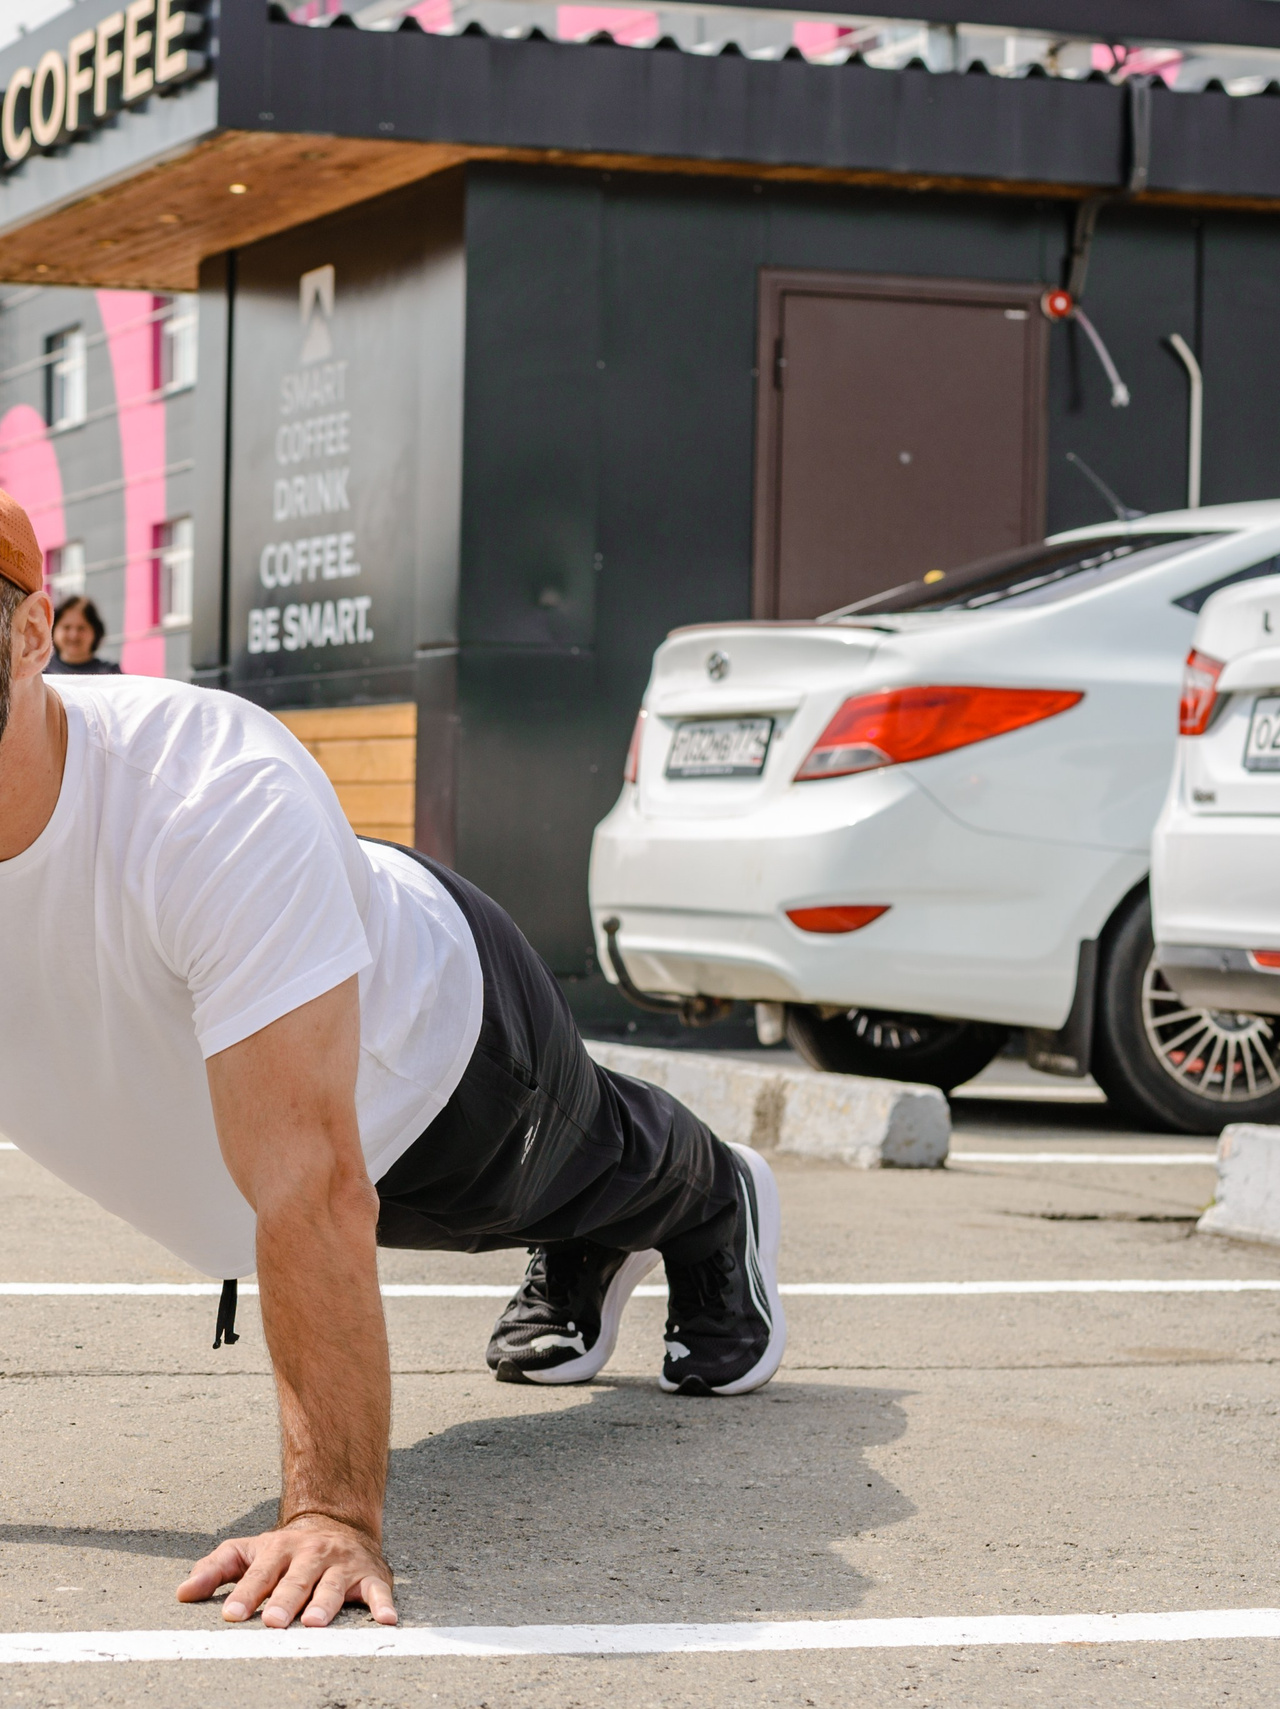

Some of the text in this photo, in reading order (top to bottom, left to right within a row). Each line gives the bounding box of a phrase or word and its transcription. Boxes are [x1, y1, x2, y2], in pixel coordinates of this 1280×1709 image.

[2, 0, 188, 161] COFFEE
[280, 360, 349, 415] SMART
[275, 411, 352, 466] COFFEE
[273, 467, 351, 522] DRINK
[259, 531, 362, 589] COFFEE.
[247, 596, 374, 655] BE SMART.
